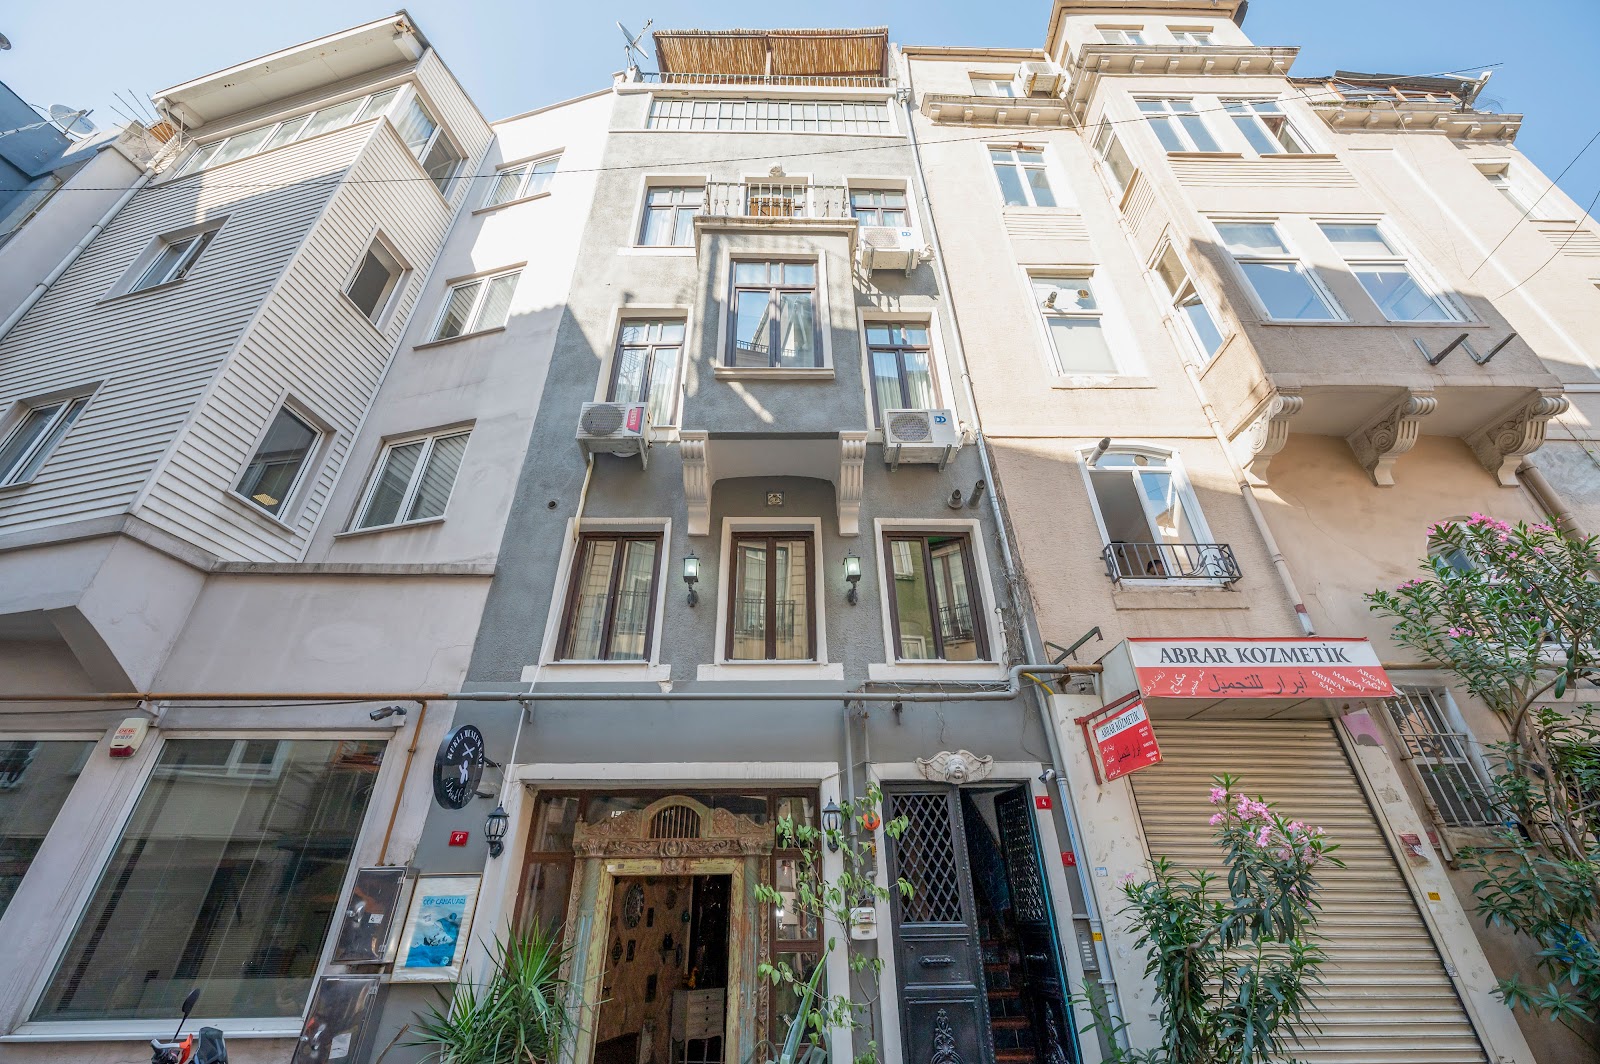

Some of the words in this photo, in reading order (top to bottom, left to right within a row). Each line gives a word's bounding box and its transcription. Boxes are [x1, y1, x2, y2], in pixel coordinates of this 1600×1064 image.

[1160, 647, 1234, 664] ABRAR
[1234, 643, 1353, 664] KOZMETİK
[1319, 682, 1335, 694] SAÇ
[1332, 671, 1365, 692] MAKYAJ
[1357, 668, 1387, 688] ARGAN
[1068, 854, 1073, 863] 4
